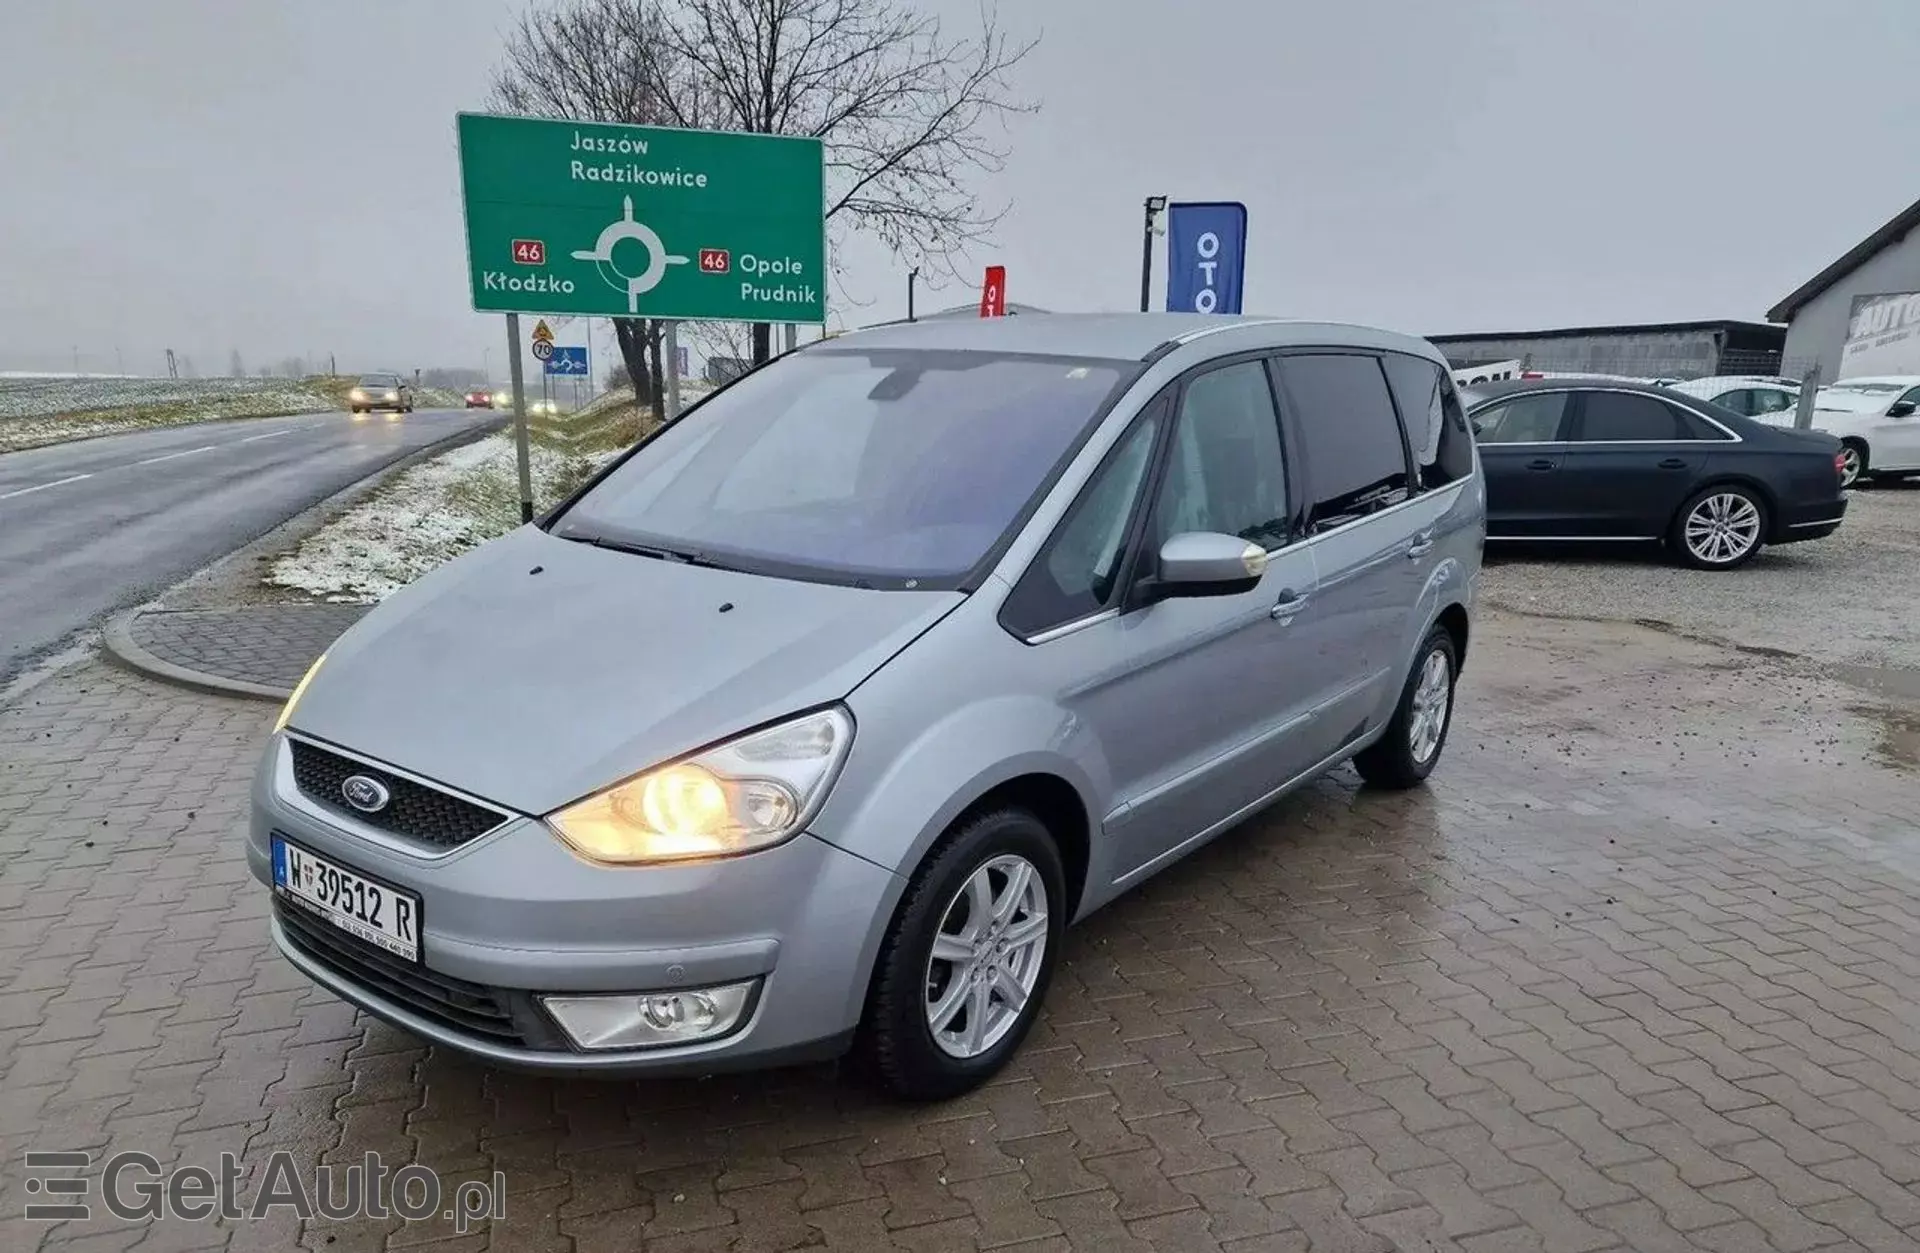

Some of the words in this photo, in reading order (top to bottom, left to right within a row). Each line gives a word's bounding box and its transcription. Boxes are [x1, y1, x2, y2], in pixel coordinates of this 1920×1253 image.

[570, 130, 649, 155] Jaszów
[571, 160, 708, 188] Radzikowice
[518, 244, 541, 261] 46
[704, 252, 726, 269] 46
[740, 254, 803, 278] Opole
[483, 271, 575, 293] Kłodzko
[741, 283, 816, 303] Prudnik
[536, 343, 552, 356] 70
[315, 860, 383, 929] 39512
[396, 897, 412, 942] R
